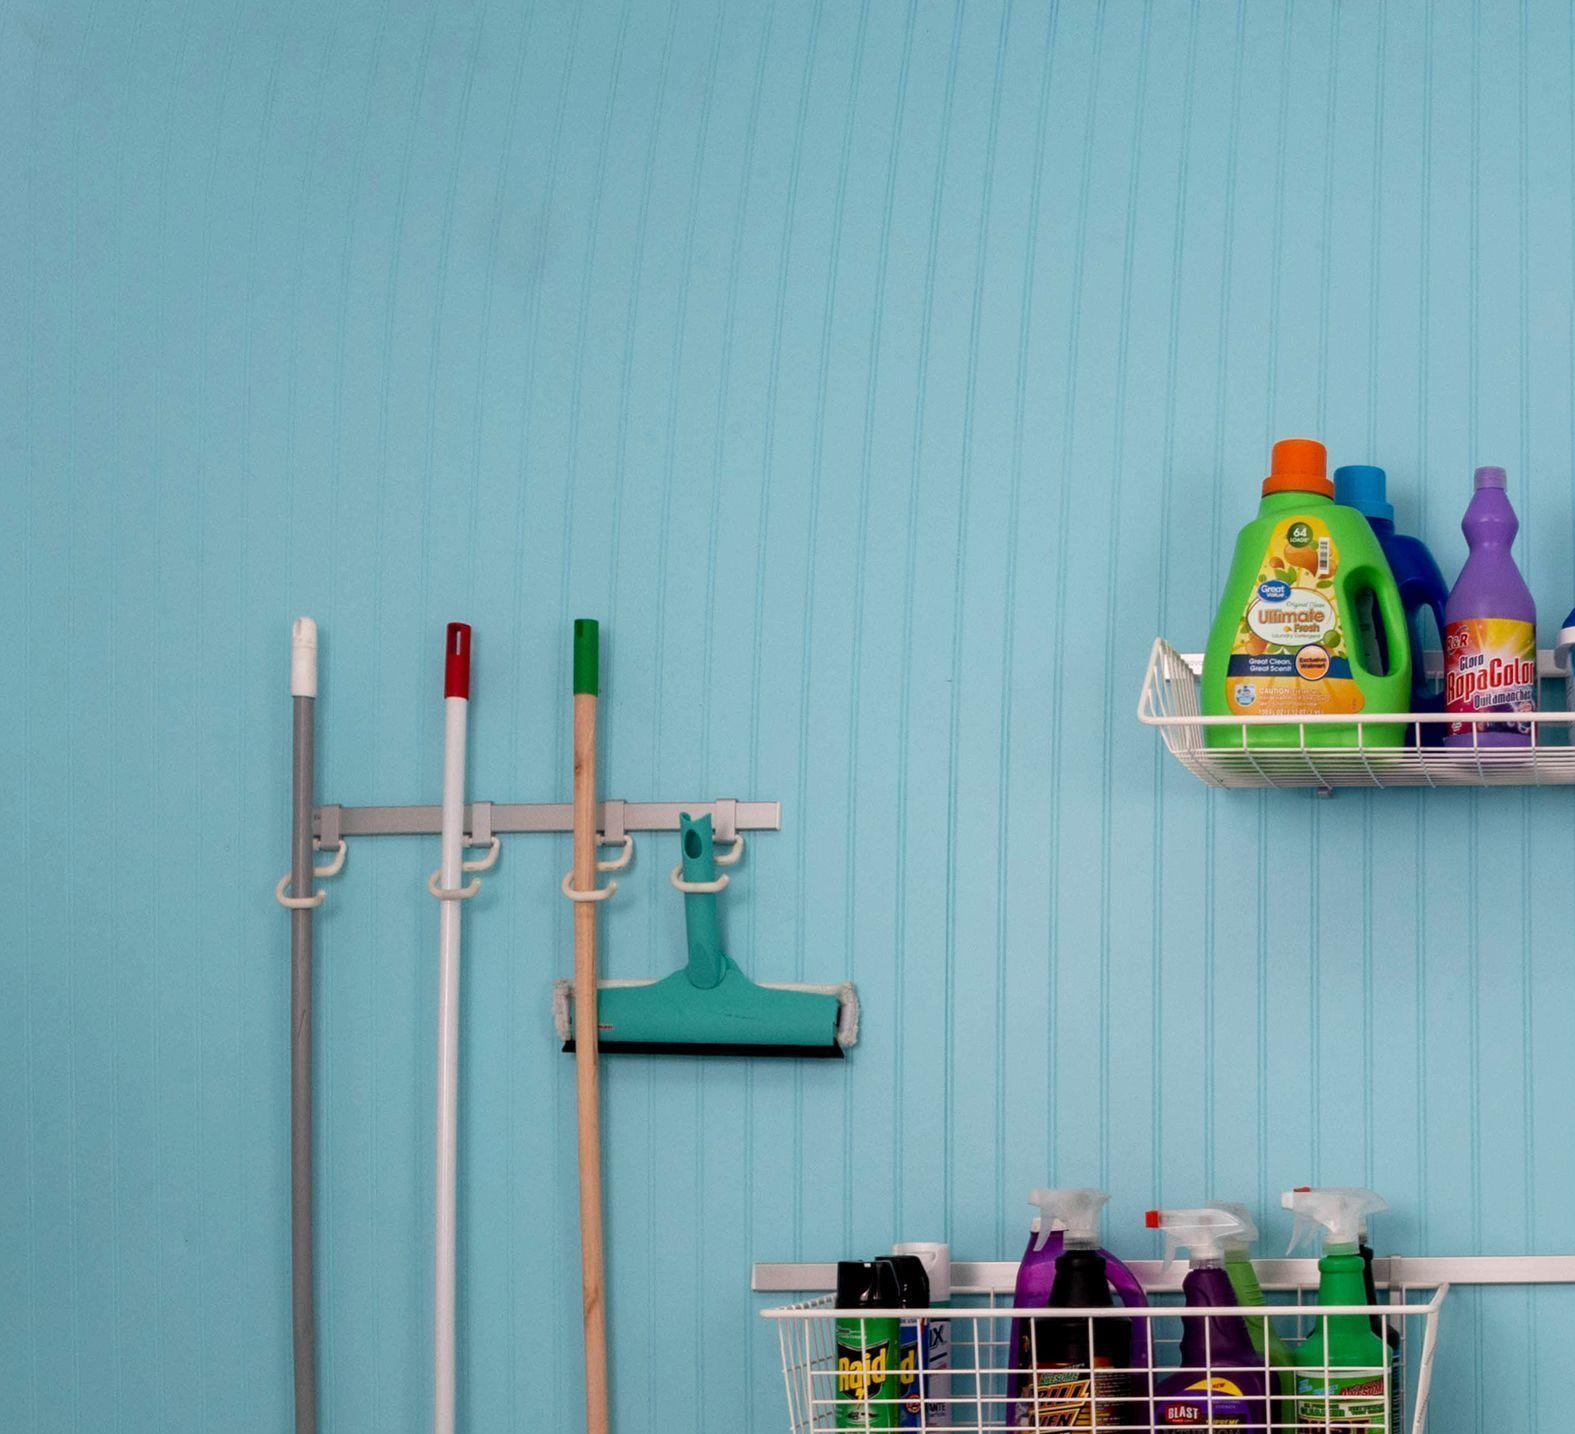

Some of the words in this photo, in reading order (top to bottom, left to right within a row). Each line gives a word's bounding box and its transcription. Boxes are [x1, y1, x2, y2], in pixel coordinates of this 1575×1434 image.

[1293, 527, 1307, 537] 64
[1260, 585, 1286, 594] Great
[1257, 608, 1326, 624] Ultimate
[1294, 623, 1320, 633] Fresh
[1459, 654, 1484, 671] Cloro
[838, 1347, 887, 1392] Raid
[1167, 1406, 1199, 1420] BLAST
